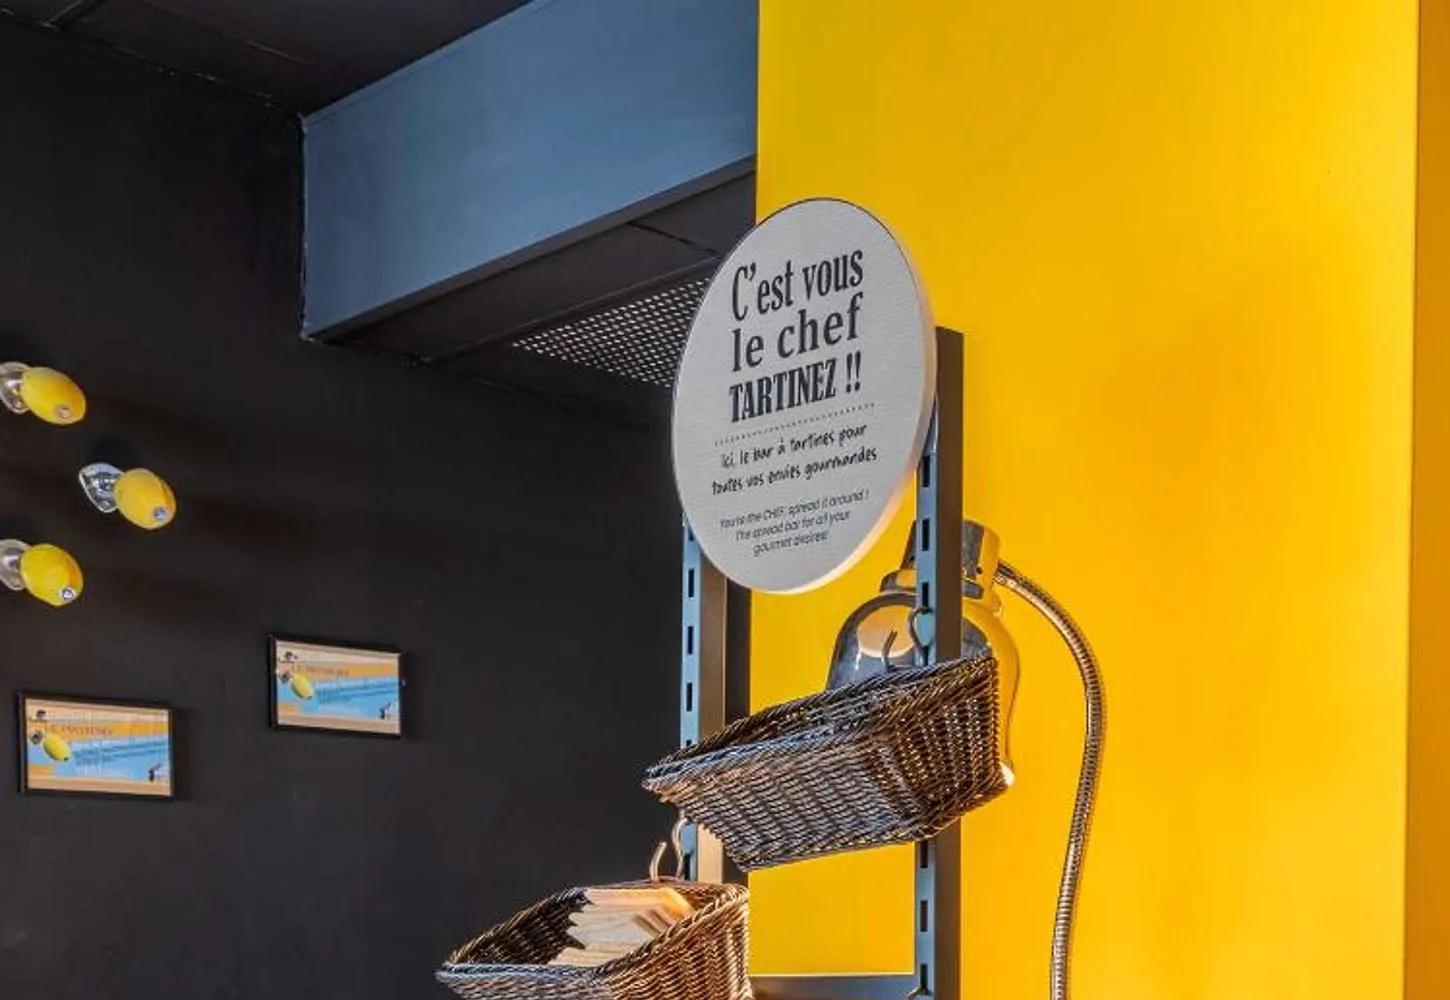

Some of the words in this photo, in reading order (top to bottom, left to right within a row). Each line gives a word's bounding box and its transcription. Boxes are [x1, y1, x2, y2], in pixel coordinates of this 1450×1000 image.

[732, 259, 794, 322] C'est
[802, 249, 864, 302] vous
[732, 328, 765, 372] le
[777, 291, 864, 358] chef
[729, 357, 837, 423] TARTINEZ
[711, 478, 744, 497] toutes
[746, 472, 765, 488] vos
[768, 463, 801, 485] envies
[804, 446, 878, 481] gourmandes
[740, 448, 749, 465] le
[753, 446, 774, 462] bar
[778, 436, 786, 455] à
[790, 429, 835, 452] tartines
[839, 424, 868, 448] pour
